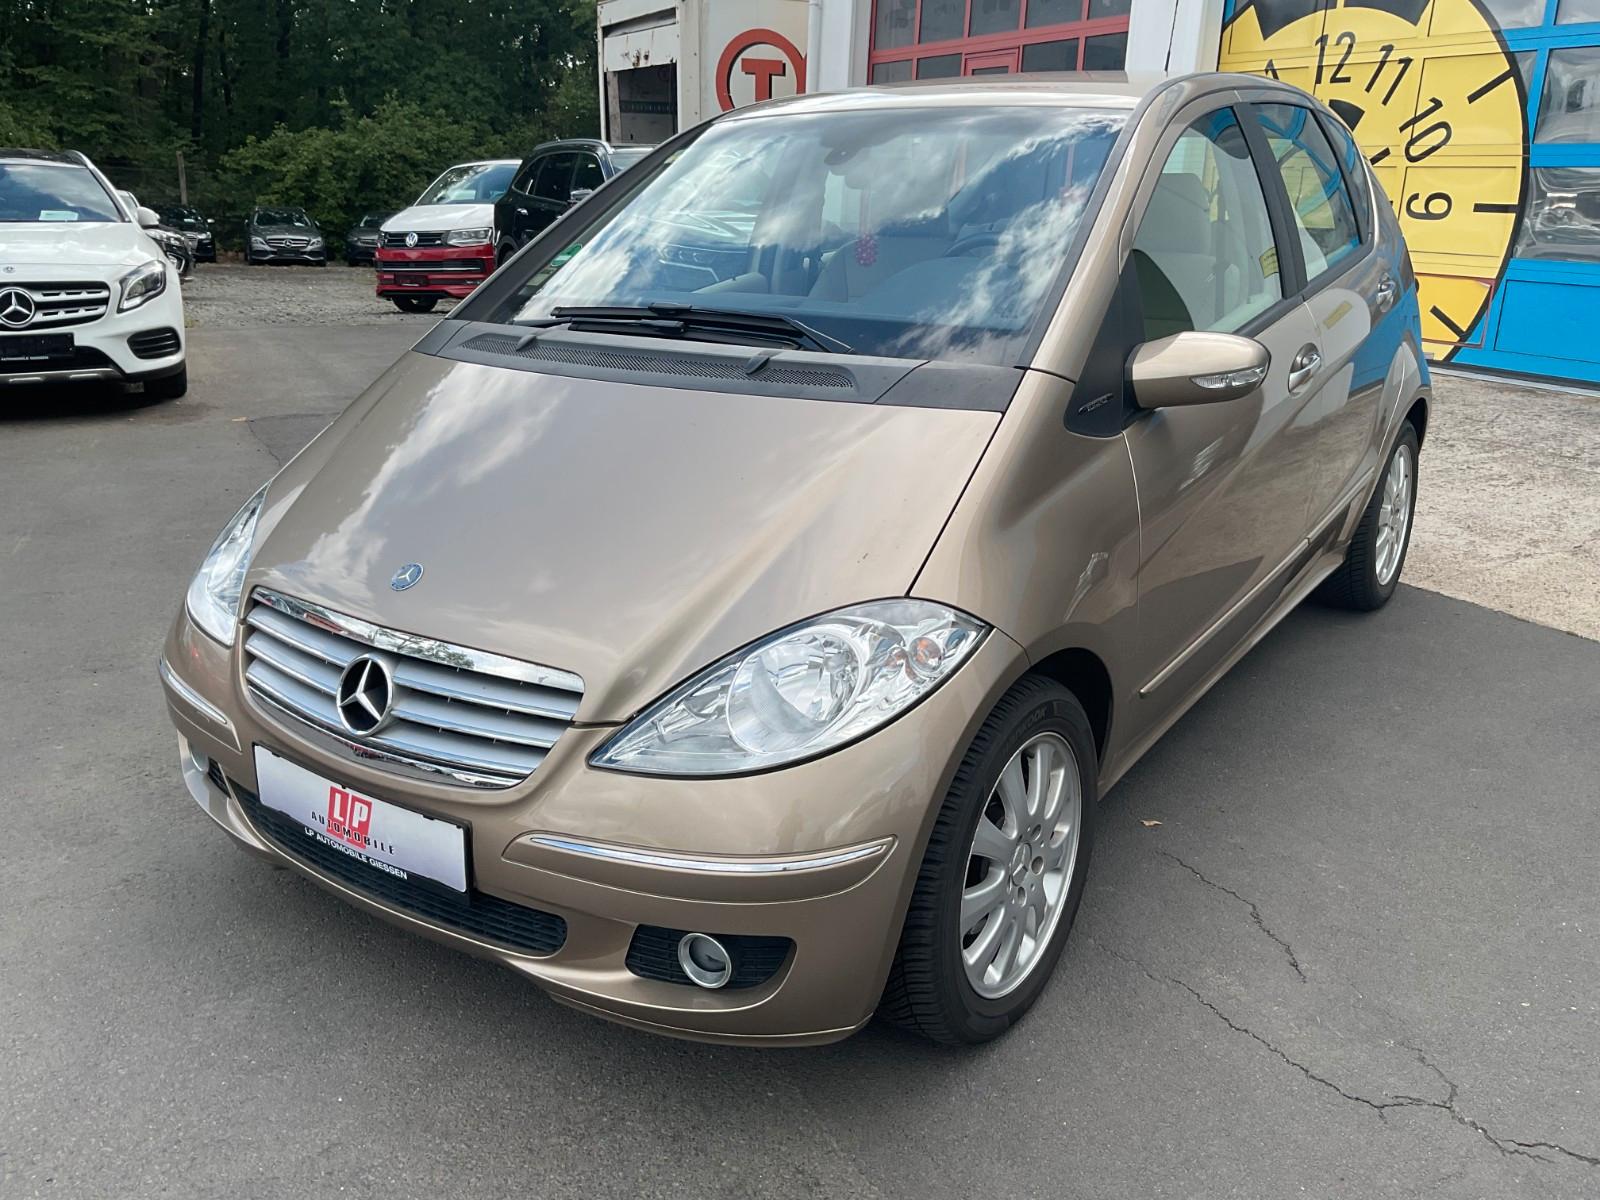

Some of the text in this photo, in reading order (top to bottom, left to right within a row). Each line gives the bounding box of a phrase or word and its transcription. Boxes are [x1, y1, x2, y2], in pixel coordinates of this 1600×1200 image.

[741, 58, 786, 102] T
[1315, 31, 1356, 84] 12
[1364, 44, 1414, 106] 11
[1398, 96, 1453, 163] 10
[311, 811, 395, 855] AUTOMOBILE
[333, 792, 369, 828] LP
[304, 826, 408, 880] LP AUTOMOBILE GIESSEN
